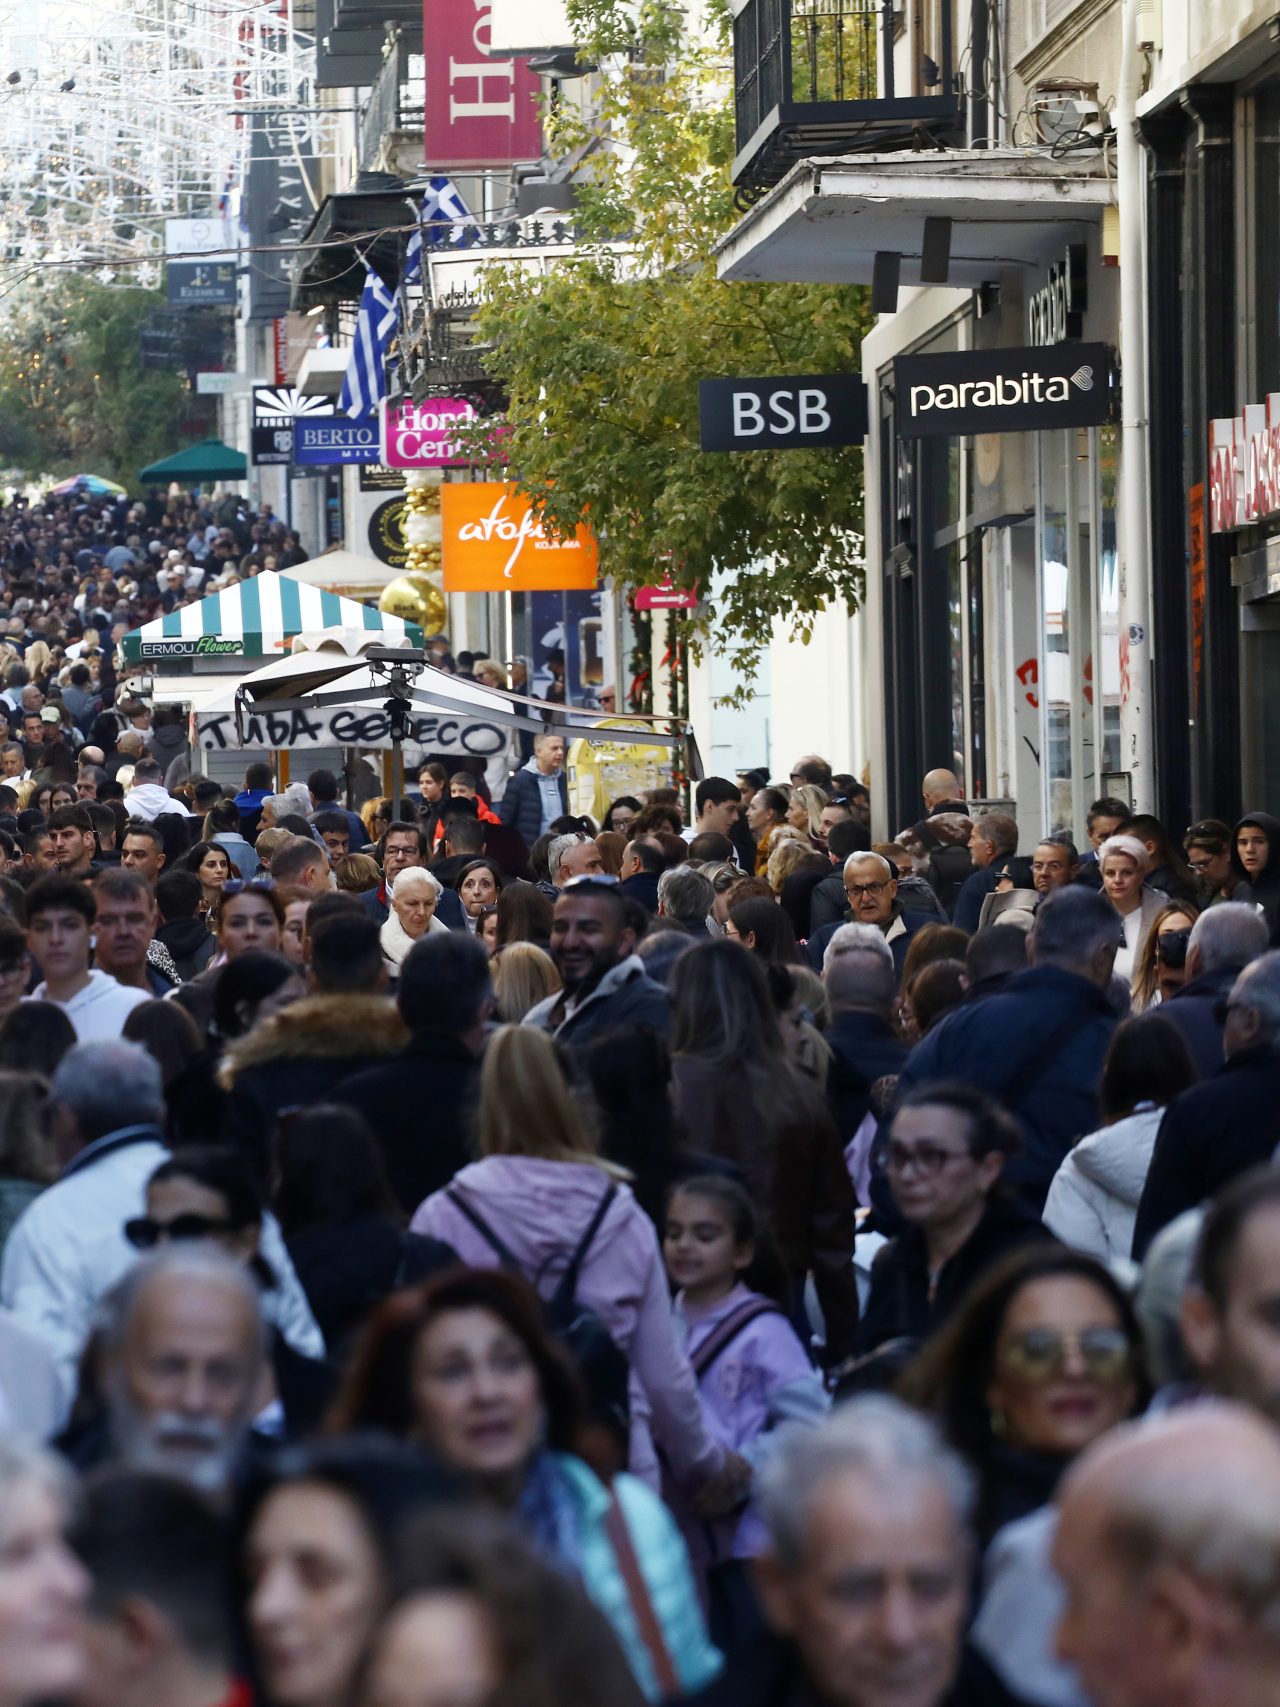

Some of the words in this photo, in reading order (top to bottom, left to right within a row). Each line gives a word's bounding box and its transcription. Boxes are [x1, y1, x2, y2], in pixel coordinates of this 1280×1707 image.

[732, 389, 832, 438] BSB
[910, 372, 1069, 417] parabita
[142, 643, 195, 655] ERMOU
[196, 636, 242, 655] Flower
